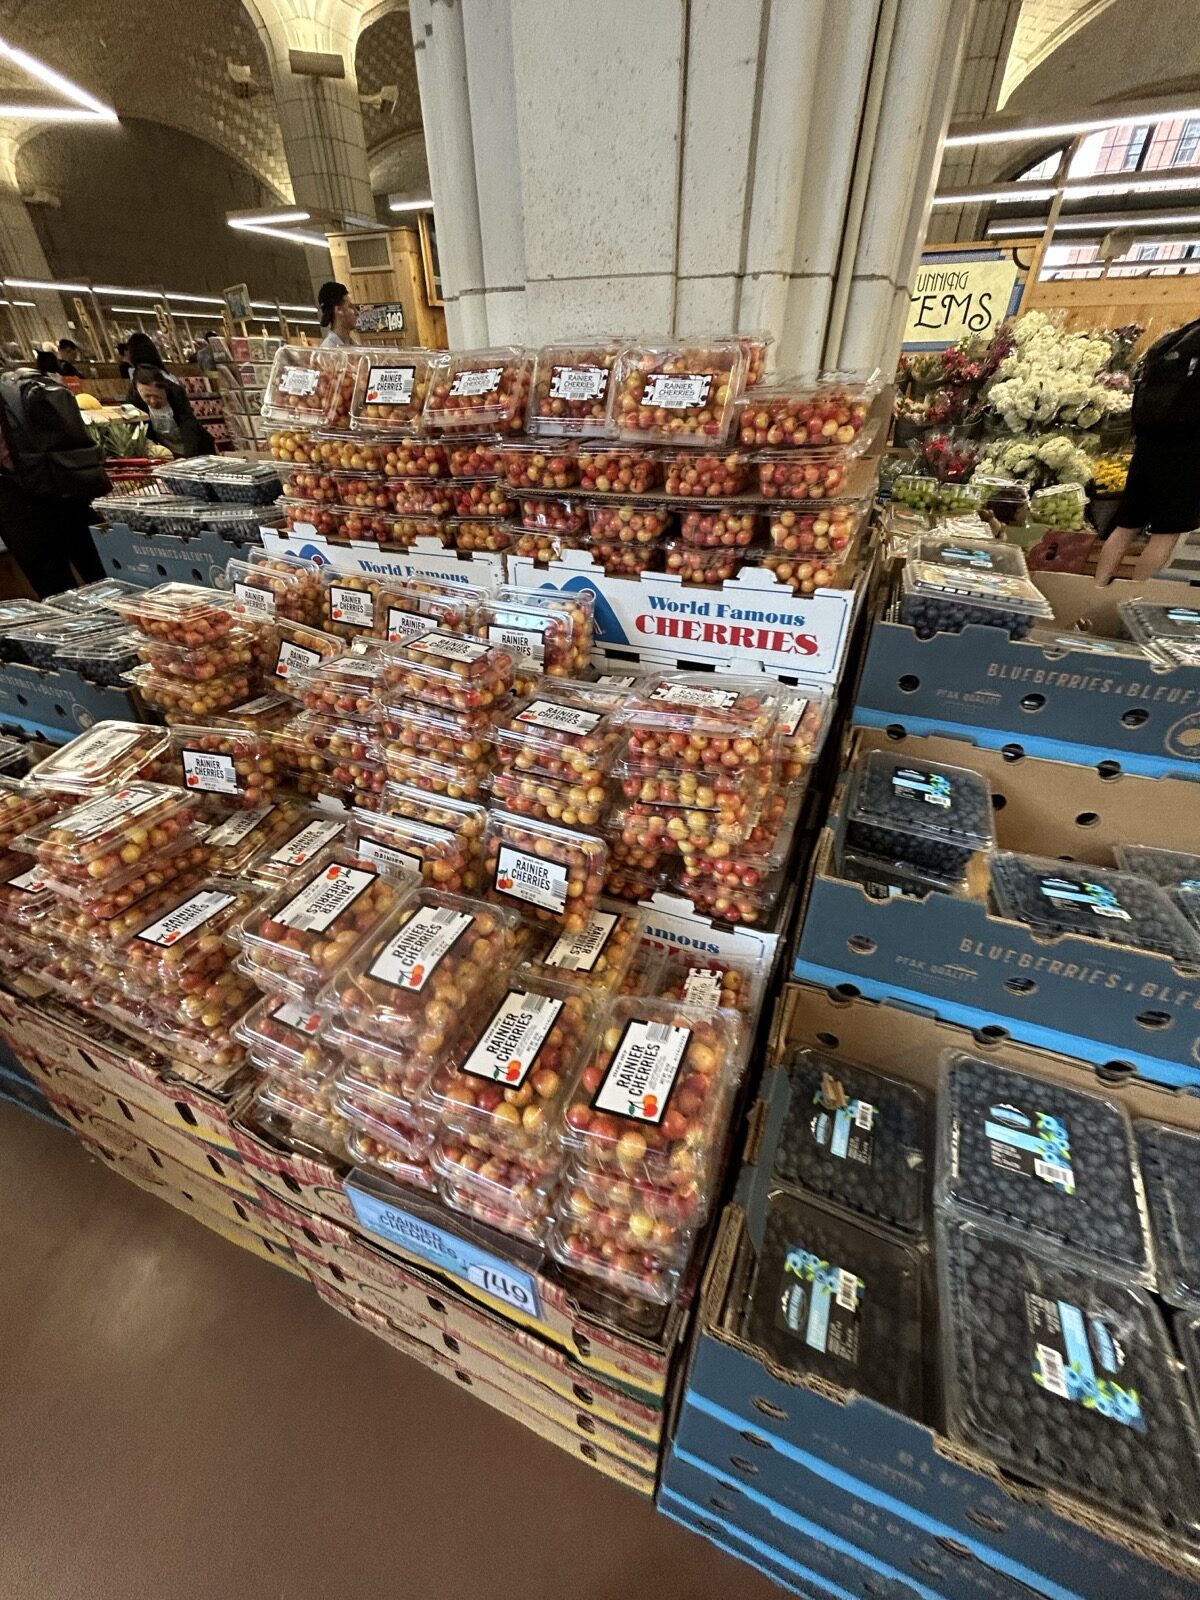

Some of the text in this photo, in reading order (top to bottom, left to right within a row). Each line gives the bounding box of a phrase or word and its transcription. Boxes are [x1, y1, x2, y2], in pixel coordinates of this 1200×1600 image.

[916, 271, 970, 292] UNNING
[911, 292, 992, 332] EMS
[376, 382, 403, 392] CHERRIES
[380, 374, 402, 383] RAINIER
[467, 374, 489, 383] RAINIER
[563, 381, 595, 389] CHERRIES
[568, 374, 593, 382] RAINIER
[663, 382, 694, 391] RAINIER
[658, 388, 695, 396] CHERRIES
[358, 559, 469, 585] World Famous
[244, 590, 265, 604] RAINIER
[339, 601, 364, 614] CHERRIES
[341, 594, 362, 605] RAINIER
[647, 595, 806, 627] World Famous
[401, 617, 426, 630] RAINIER
[438, 639, 471, 651] RAINIER
[501, 634, 529, 647] RAINIER
[635, 614, 819, 656] CHERRIES
[290, 650, 310, 664] RAINIER
[429, 642, 469, 654] CHERRIES
[286, 659, 309, 670] CHERR
[987, 663, 1114, 694] BLUEBERRIES
[538, 711, 580, 726] CHERRIES
[546, 707, 581, 721] RAINIER
[194, 766, 224, 780] CHERRIES
[195, 758, 221, 770] RAINIER
[287, 831, 314, 853] RAINIER
[292, 831, 324, 857] CHERRIES
[511, 867, 551, 890] CHERRIES
[515, 860, 549, 879] RAINIER
[305, 879, 347, 914] CHERRIES
[322, 885, 355, 915] RAINIER
[162, 903, 199, 928] RAINIER
[165, 904, 209, 933] CHERRIES
[392, 923, 429, 958] RAINIER
[401, 924, 443, 967] CHERRIES
[581, 926, 604, 954] RAINIER
[643, 924, 721, 955] amous
[959, 938, 1121, 989] BLUEBERRIES
[486, 1012, 519, 1055] RAINIER
[496, 1012, 534, 1063] CHERRIES
[615, 1043, 646, 1089] RAINIER
[628, 1043, 661, 1097] CHERRIES
[385, 1210, 443, 1242] RAINIER
[379, 1215, 458, 1260] CHERRIES
